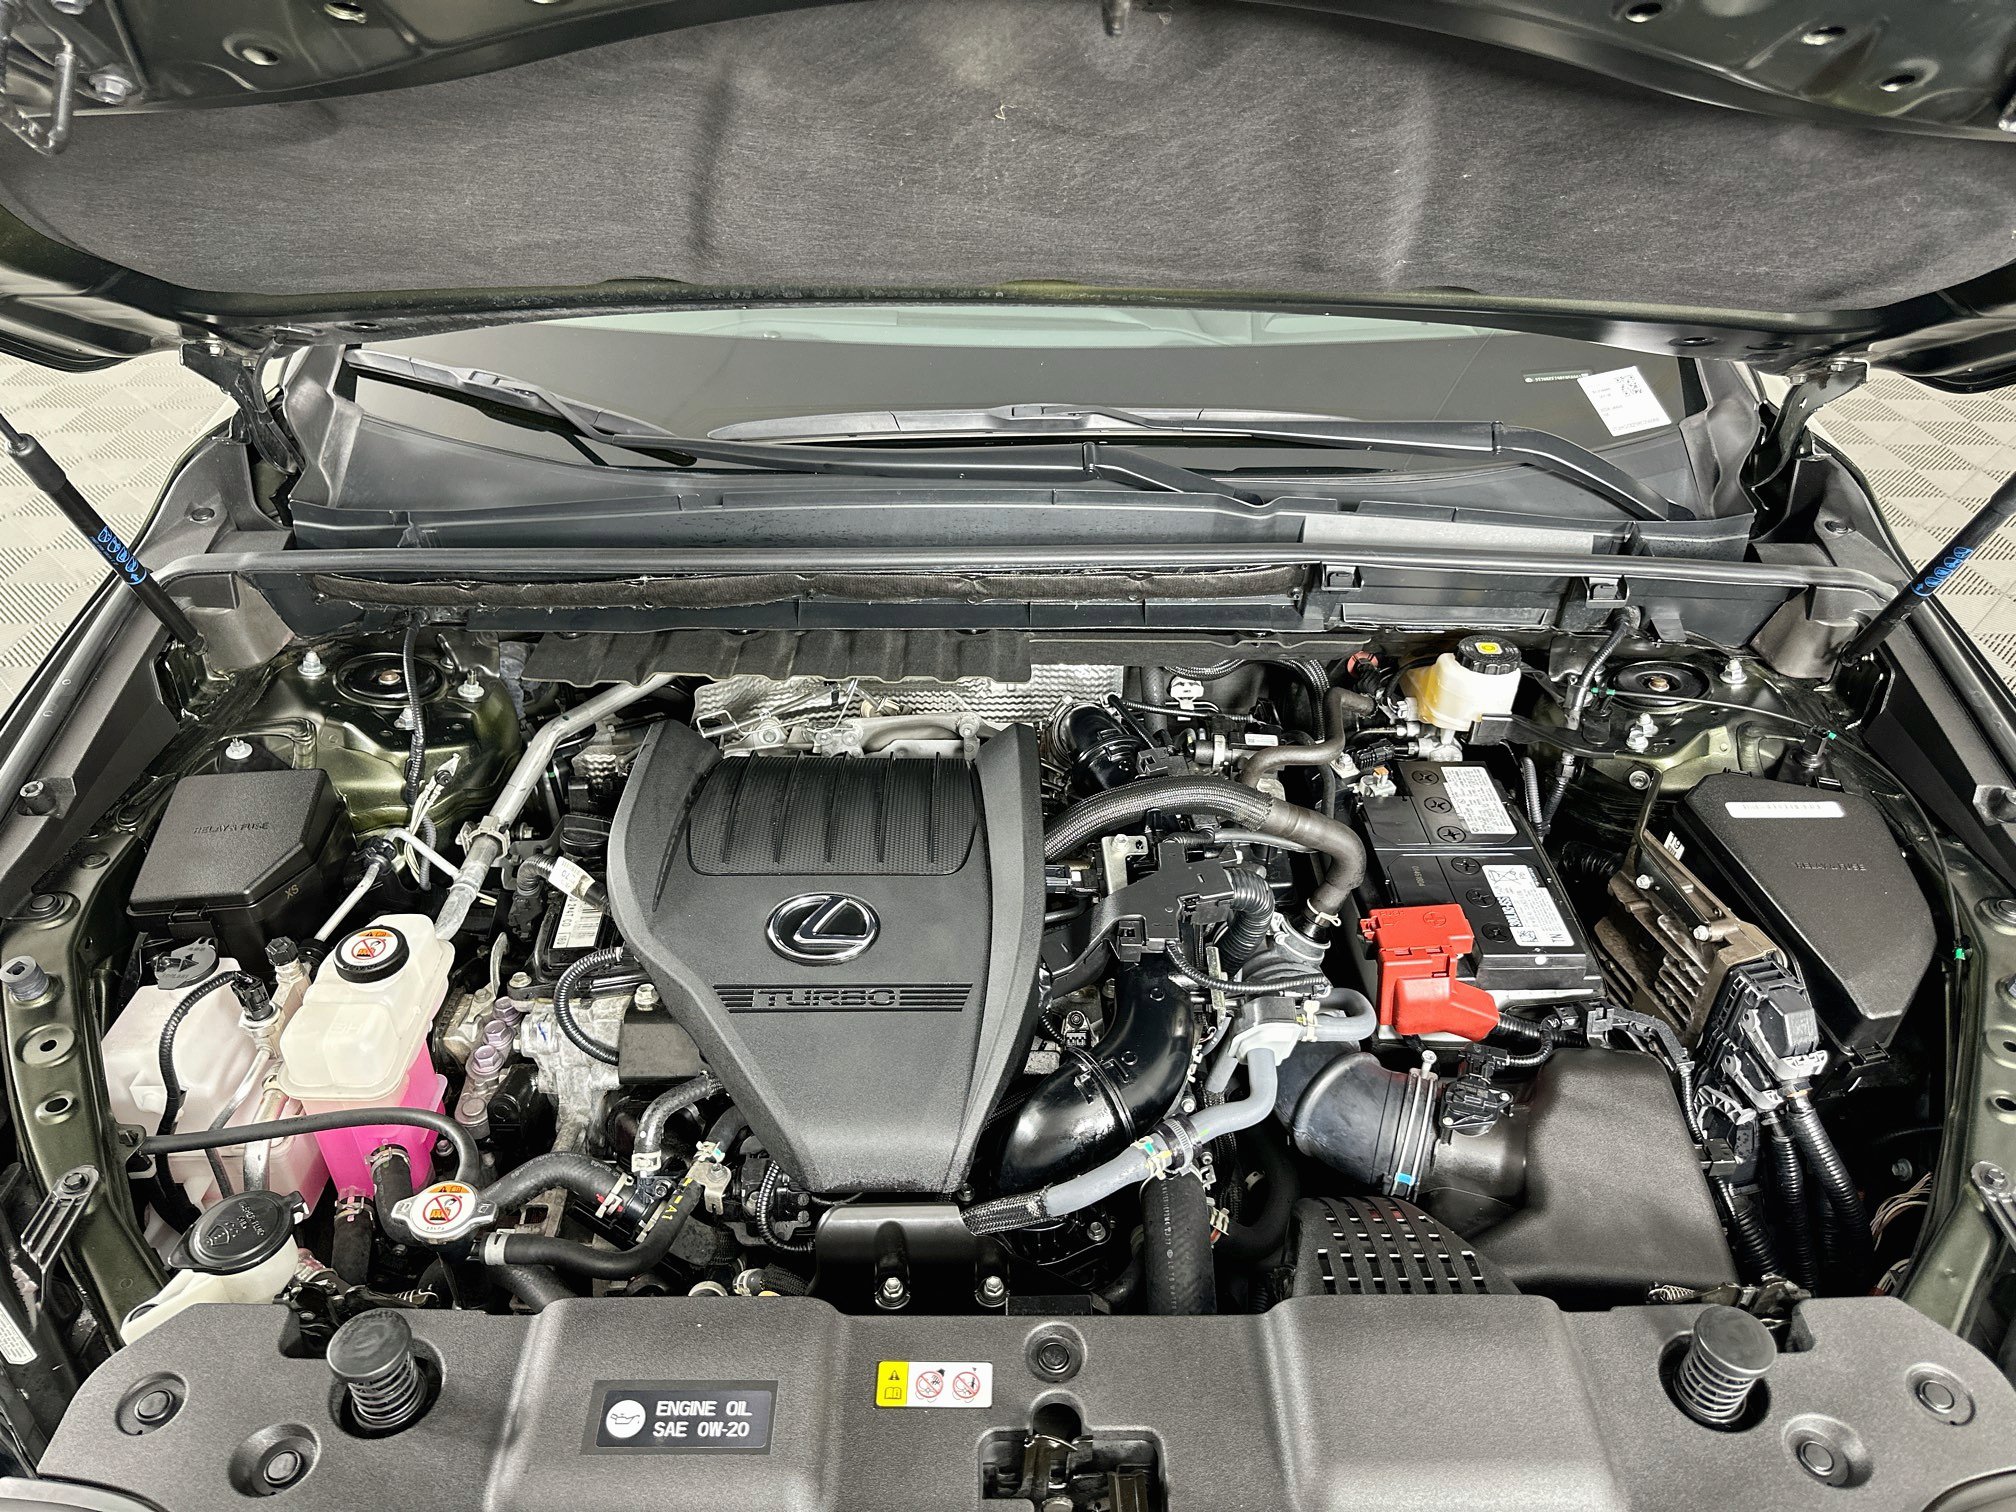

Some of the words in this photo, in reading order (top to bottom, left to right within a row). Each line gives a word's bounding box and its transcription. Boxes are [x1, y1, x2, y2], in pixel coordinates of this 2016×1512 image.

[193, 824, 229, 834] RELAY
[240, 822, 269, 831] FUSE
[1838, 863, 1867, 871] FUSE
[284, 884, 299, 900] XS
[1549, 933, 1565, 943] TN
[758, 988, 896, 1007] TURBO
[655, 1400, 718, 1416] ENGINE
[725, 1400, 753, 1416] OIL
[652, 1421, 689, 1437] SAE
